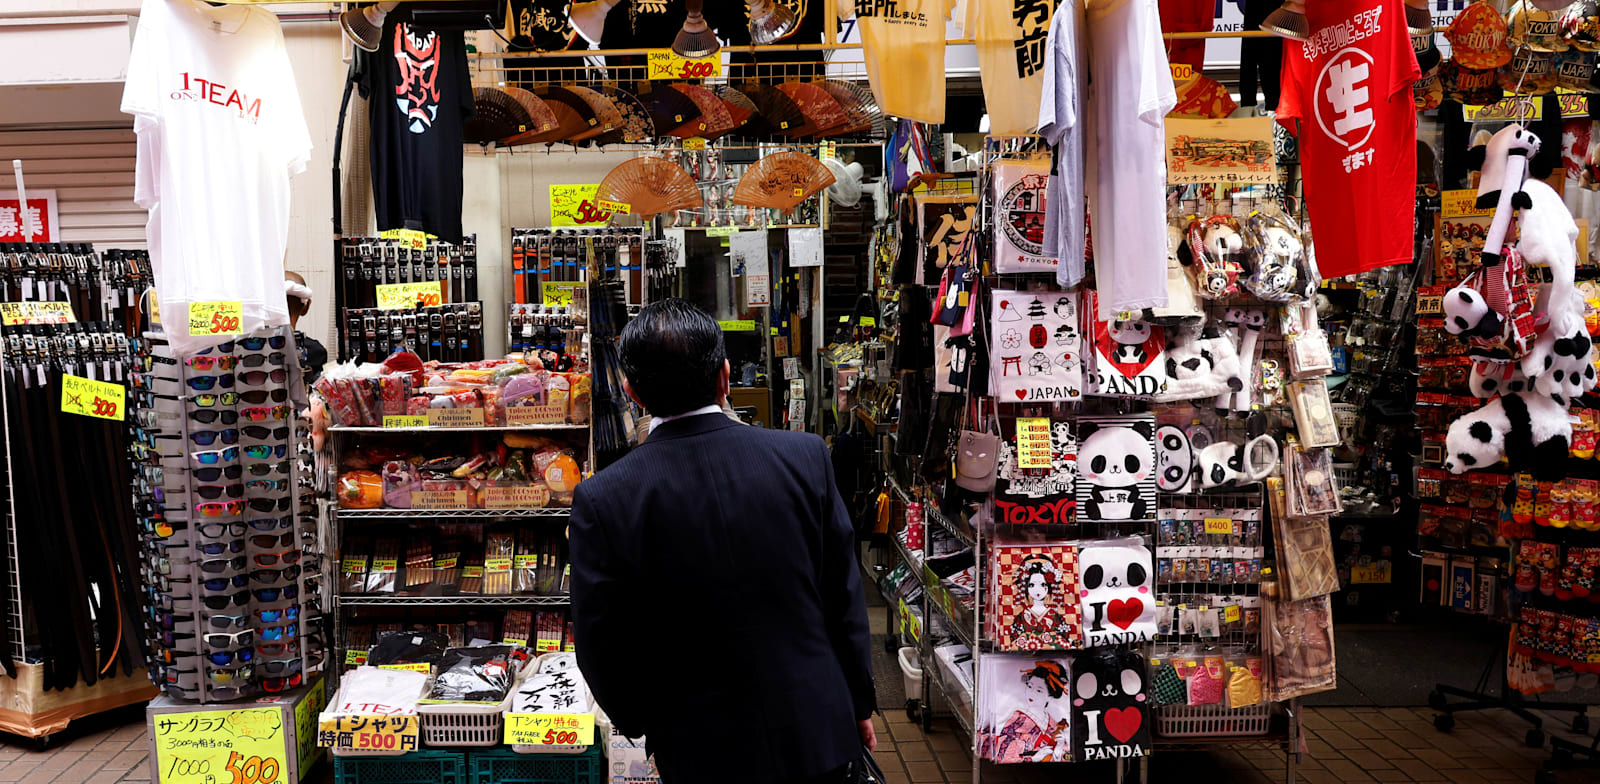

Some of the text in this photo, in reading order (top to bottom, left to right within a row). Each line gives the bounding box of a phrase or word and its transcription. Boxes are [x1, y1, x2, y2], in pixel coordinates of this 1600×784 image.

[404, 21, 436, 52] JAPAN
[649, 53, 670, 61] JAPAN
[679, 61, 713, 78] 500
[179, 72, 191, 90] 1
[194, 78, 262, 118] TEAM
[1327, 59, 1373, 137] 生
[1172, 158, 1186, 172] 祝
[1174, 174, 1272, 182] シャオシャオ レイレイ
[573, 199, 611, 224] 500
[0, 206, 43, 238] 募集
[1026, 257, 1052, 265] TOKYO
[413, 292, 440, 306] 500
[1418, 298, 1439, 309] 東京
[210, 312, 240, 333] 500
[1029, 386, 1074, 400] JAPAN
[92, 395, 117, 417] 500
[1104, 493, 1127, 503] 上野
[996, 498, 1077, 524] TOKYO
[1207, 521, 1229, 531] ¥400
[1090, 602, 1106, 632] I
[1090, 630, 1146, 648] PANDA
[159, 716, 226, 736] サングラス
[333, 714, 409, 734] Tシャツ
[511, 716, 580, 728] Tシャツ 特価
[1083, 710, 1102, 745] I
[319, 731, 417, 750] 特価 500 円
[541, 728, 578, 745] 500
[1084, 744, 1143, 761] PANDA
[225, 751, 280, 784] 500
